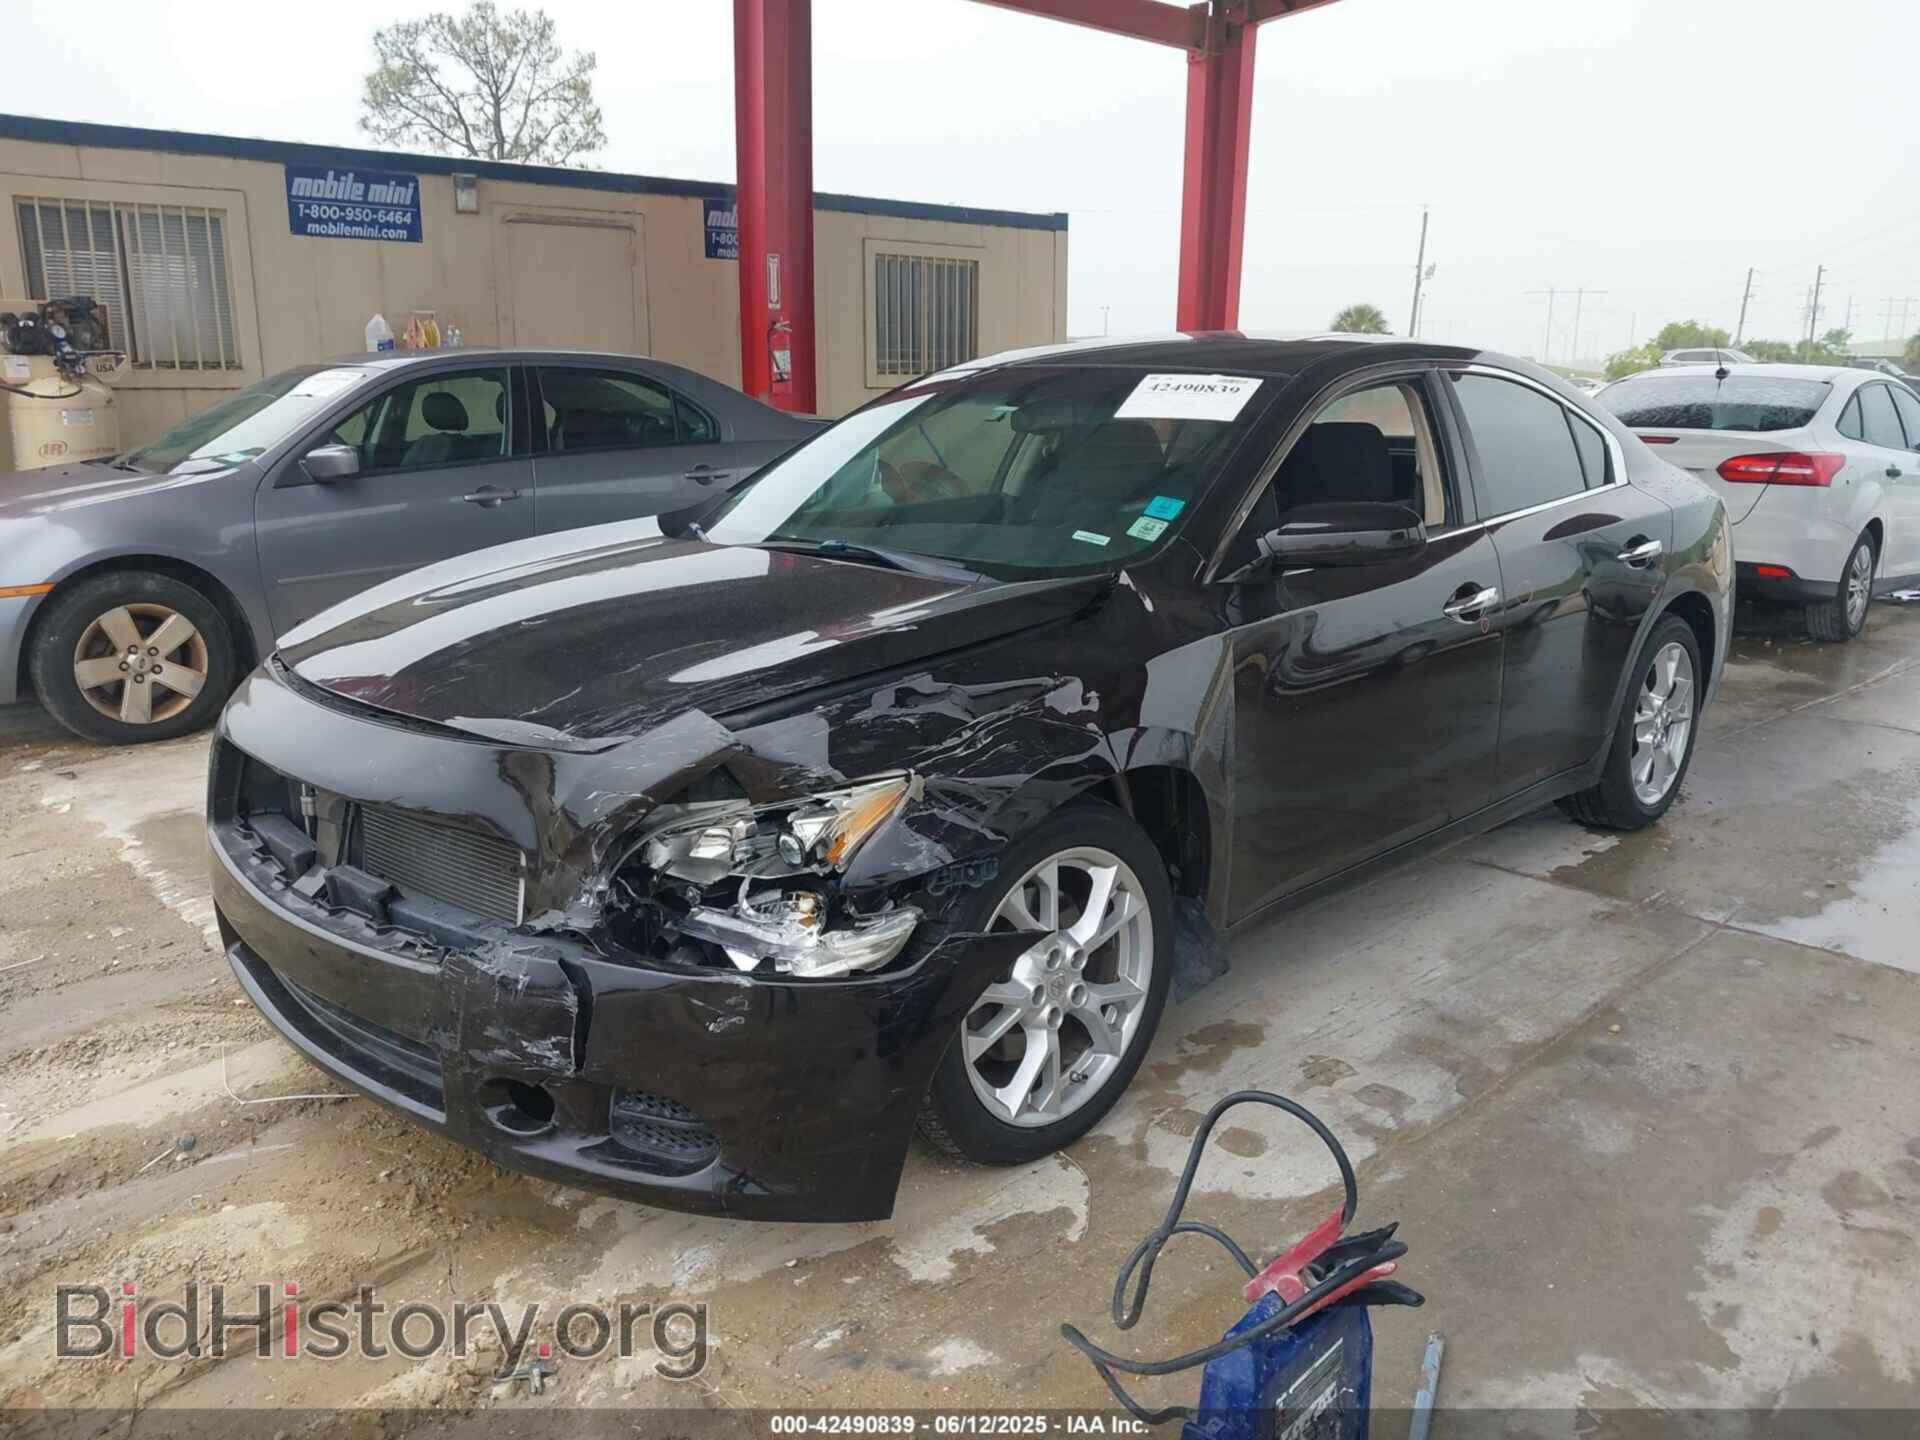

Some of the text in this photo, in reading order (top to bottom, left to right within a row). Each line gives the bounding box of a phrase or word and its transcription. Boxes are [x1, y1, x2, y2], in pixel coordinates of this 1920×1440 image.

[291, 171, 415, 205] mobile mini
[299, 204, 411, 224] 1-800-950-6464
[306, 222, 408, 240] mobilemini.com
[1148, 383, 1240, 393] 42490839
